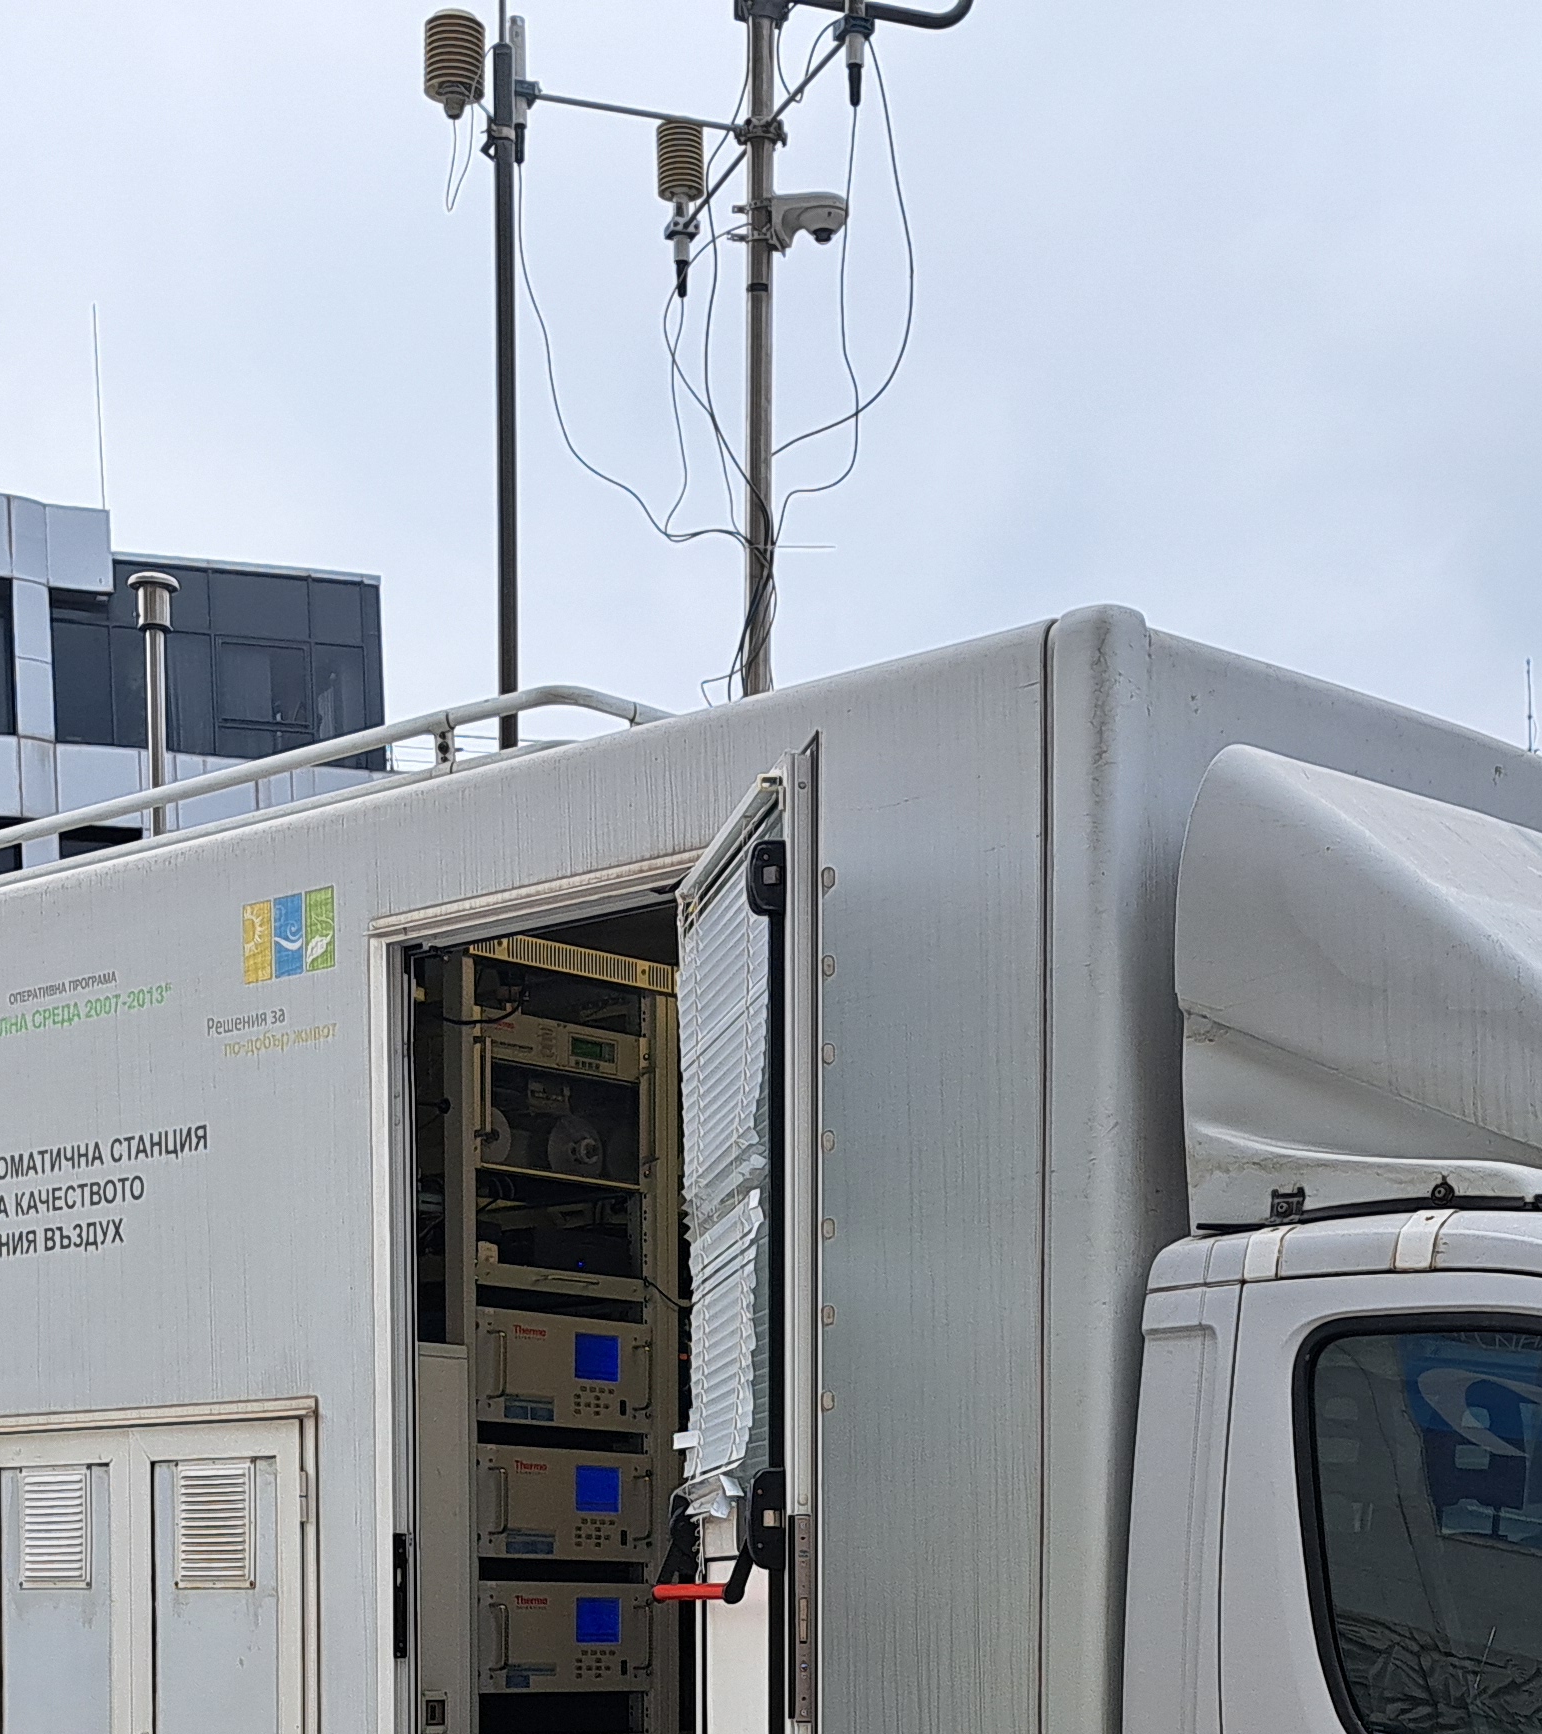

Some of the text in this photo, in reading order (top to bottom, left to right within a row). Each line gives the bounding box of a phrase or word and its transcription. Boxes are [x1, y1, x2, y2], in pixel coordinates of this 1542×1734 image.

[9, 971, 117, 1005] ОПЕРАТИВНА ПРОГРАМА
[32, 1001, 82, 1028] СРЕДА
[206, 1008, 286, 1036] Решения за
[224, 1022, 337, 1056] по-добър живот
[110, 1124, 208, 1163] СТАНЦИЯ
[15, 1175, 145, 1216] КАЧЕСТВОТО
[44, 1218, 125, 1252] ВЪЗДУХ
